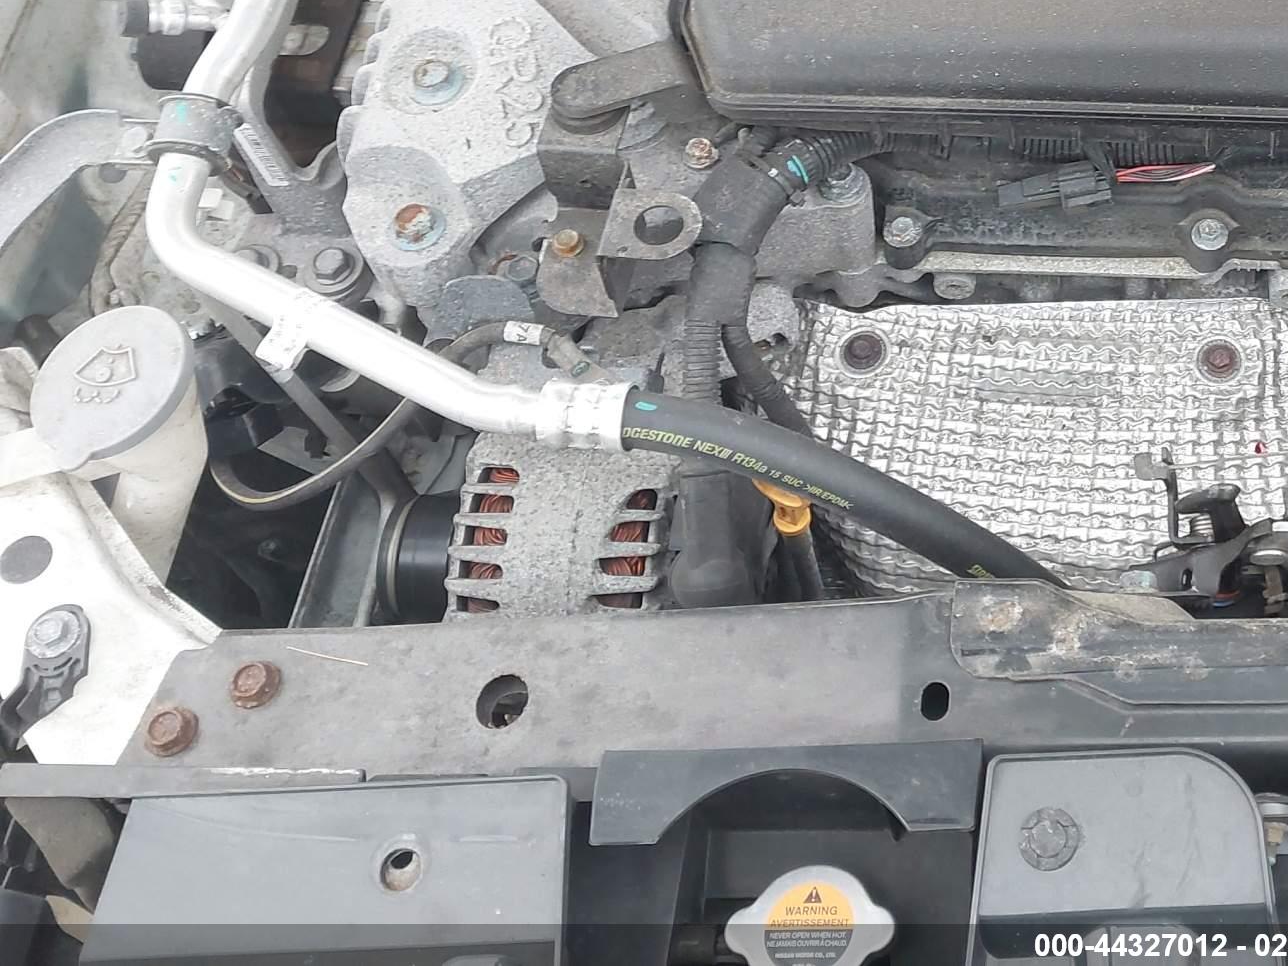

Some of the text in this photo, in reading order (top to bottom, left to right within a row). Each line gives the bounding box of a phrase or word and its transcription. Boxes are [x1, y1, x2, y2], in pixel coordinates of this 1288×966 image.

[781, 474, 804, 488] SUC
[785, 905, 838, 917] WARNING
[769, 918, 850, 928] AVERTISSEMENT
[769, 931, 847, 940] NEVER OPEN WHEN HOT.
